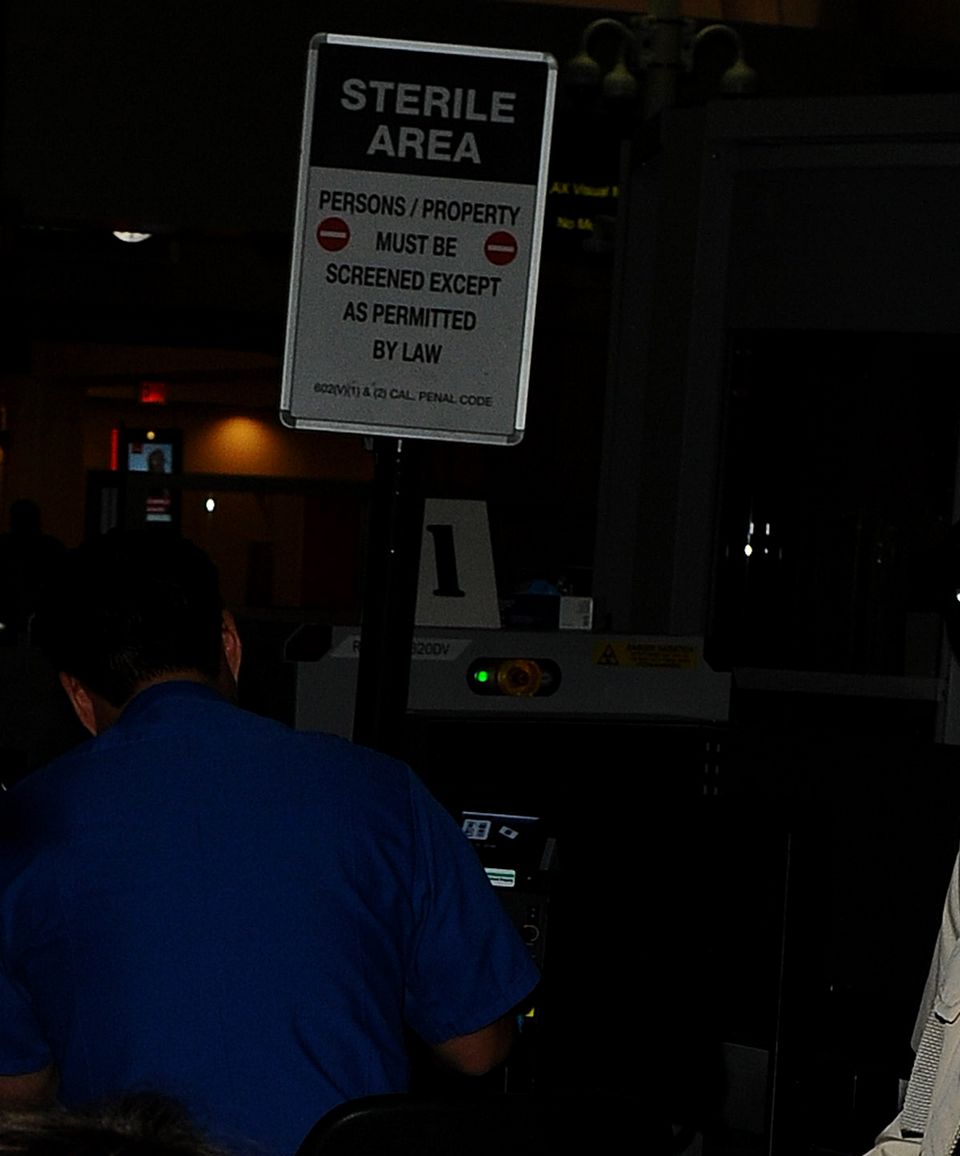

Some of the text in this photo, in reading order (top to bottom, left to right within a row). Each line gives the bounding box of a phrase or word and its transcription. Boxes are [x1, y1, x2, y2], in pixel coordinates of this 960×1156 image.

[340, 78, 518, 125] STERILE
[366, 124, 482, 165] AREA
[319, 190, 521, 226] PERSONS / PROPERTY
[376, 231, 457, 257] MUST BE
[326, 262, 502, 297] SCREENED EXCEPT
[343, 301, 477, 331] AS PERMITTED
[373, 340, 443, 364] BY LAW
[362, 386, 371, 398] &
[373, 387, 388, 400] (2)
[418, 390, 457, 405] PENAL
[459, 394, 494, 408] CODE
[426, 524, 466, 598] 1
